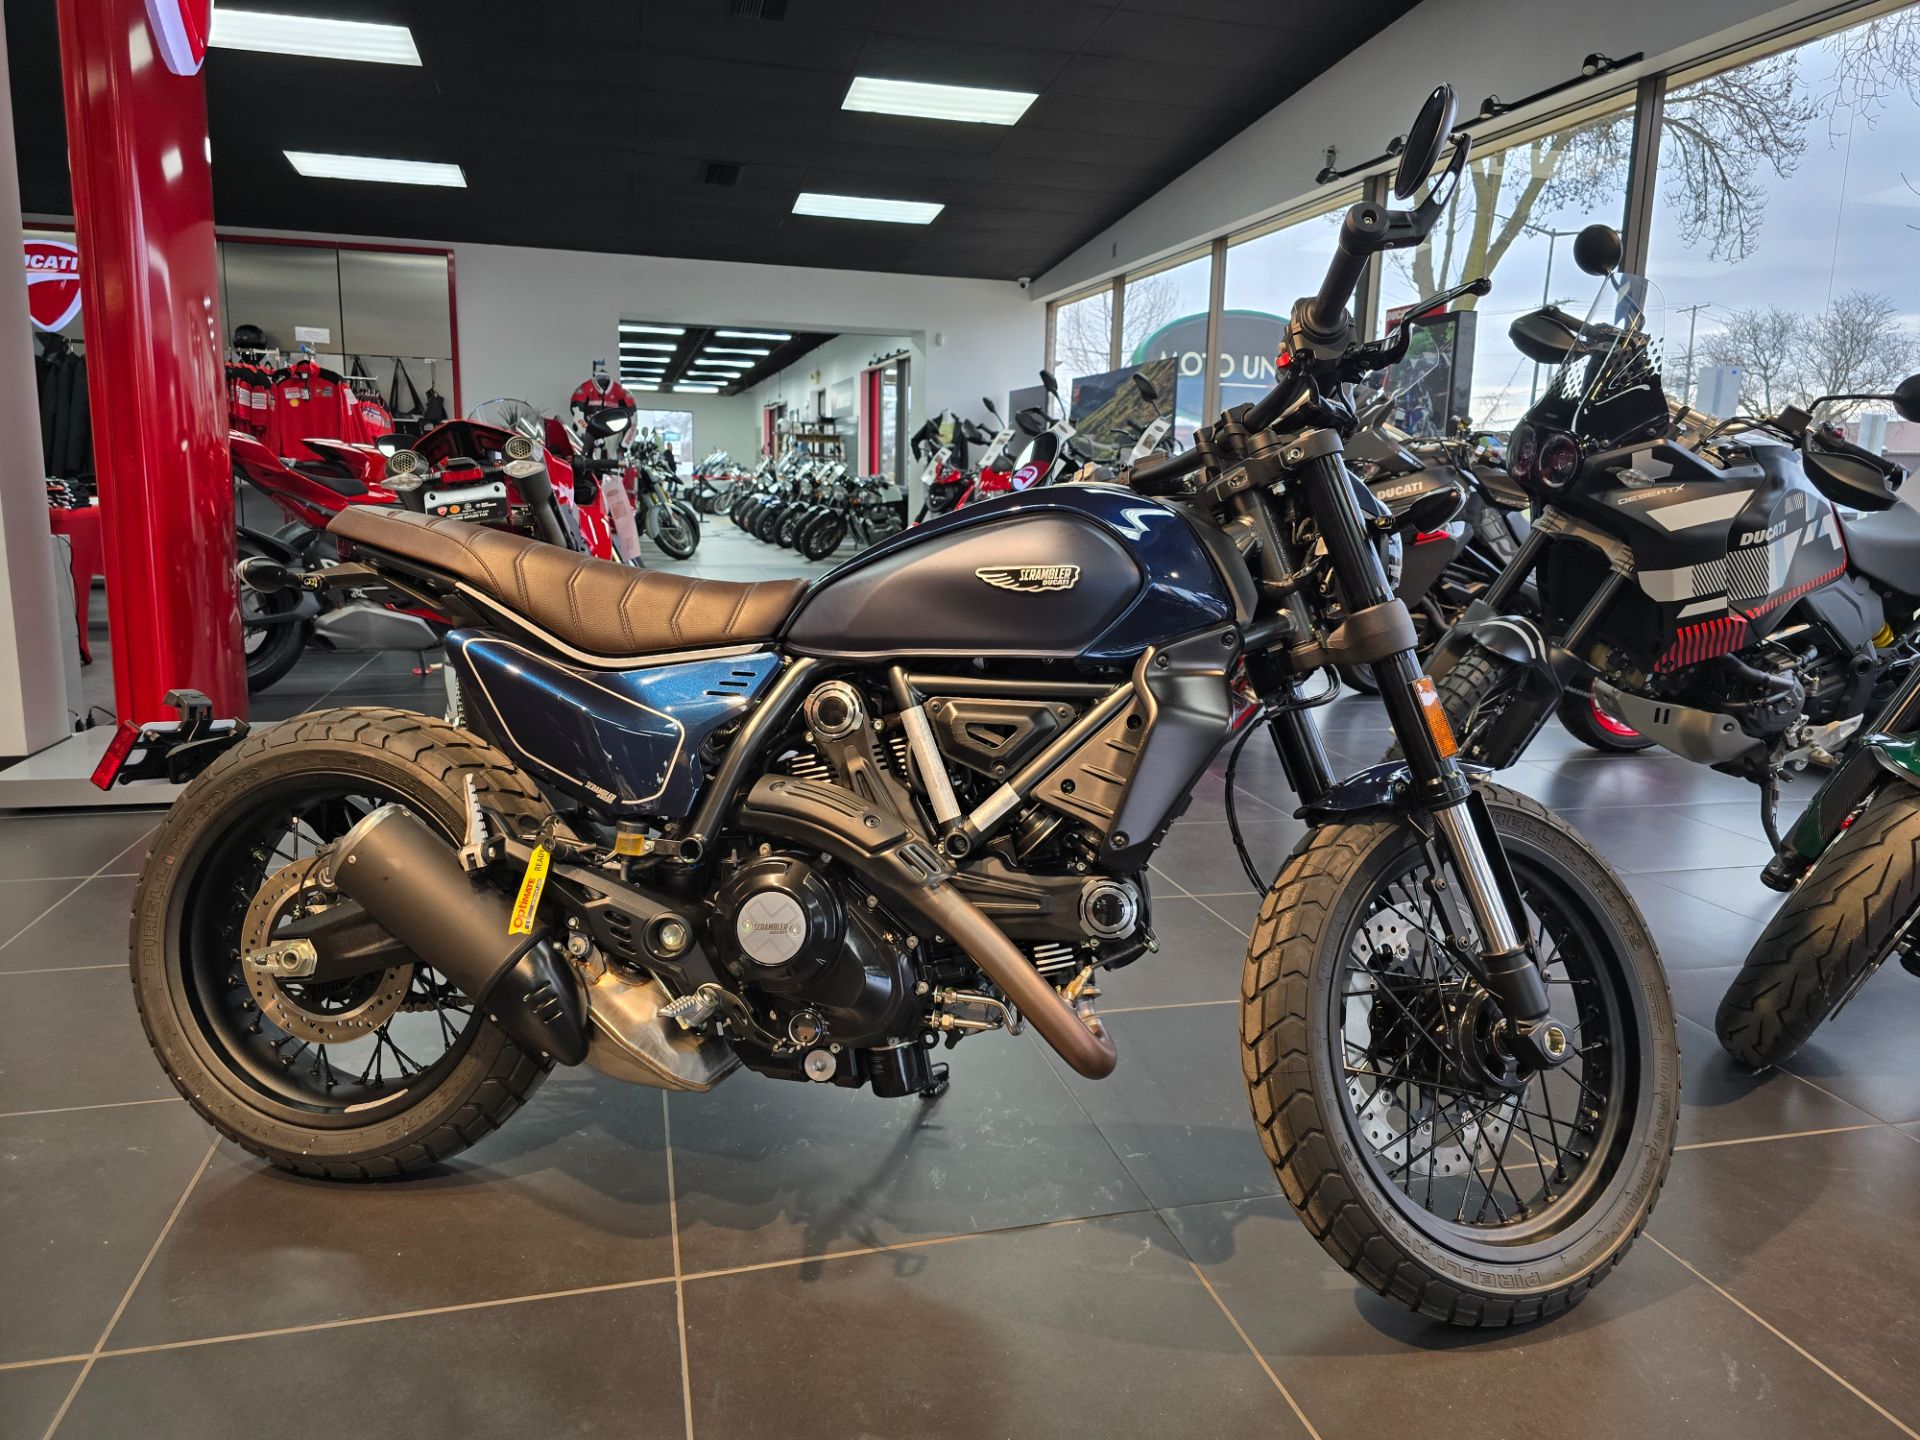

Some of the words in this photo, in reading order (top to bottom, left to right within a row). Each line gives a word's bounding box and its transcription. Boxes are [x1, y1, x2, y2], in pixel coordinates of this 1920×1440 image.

[24, 253, 78, 271] CATI
[1242, 354, 1277, 379] UN
[1376, 481, 1423, 500] DUCATI
[1617, 483, 1686, 505] DESERTX
[1739, 519, 1787, 546] DUCATI
[1019, 567, 1072, 581] SCRAMBLER
[142, 854, 176, 967] PIRELLI
[167, 789, 228, 855] MT60
[513, 877, 536, 929] OptiMATE
[753, 922, 789, 931] SCRAMBLER
[1437, 1255, 1542, 1289] PIRELLI
